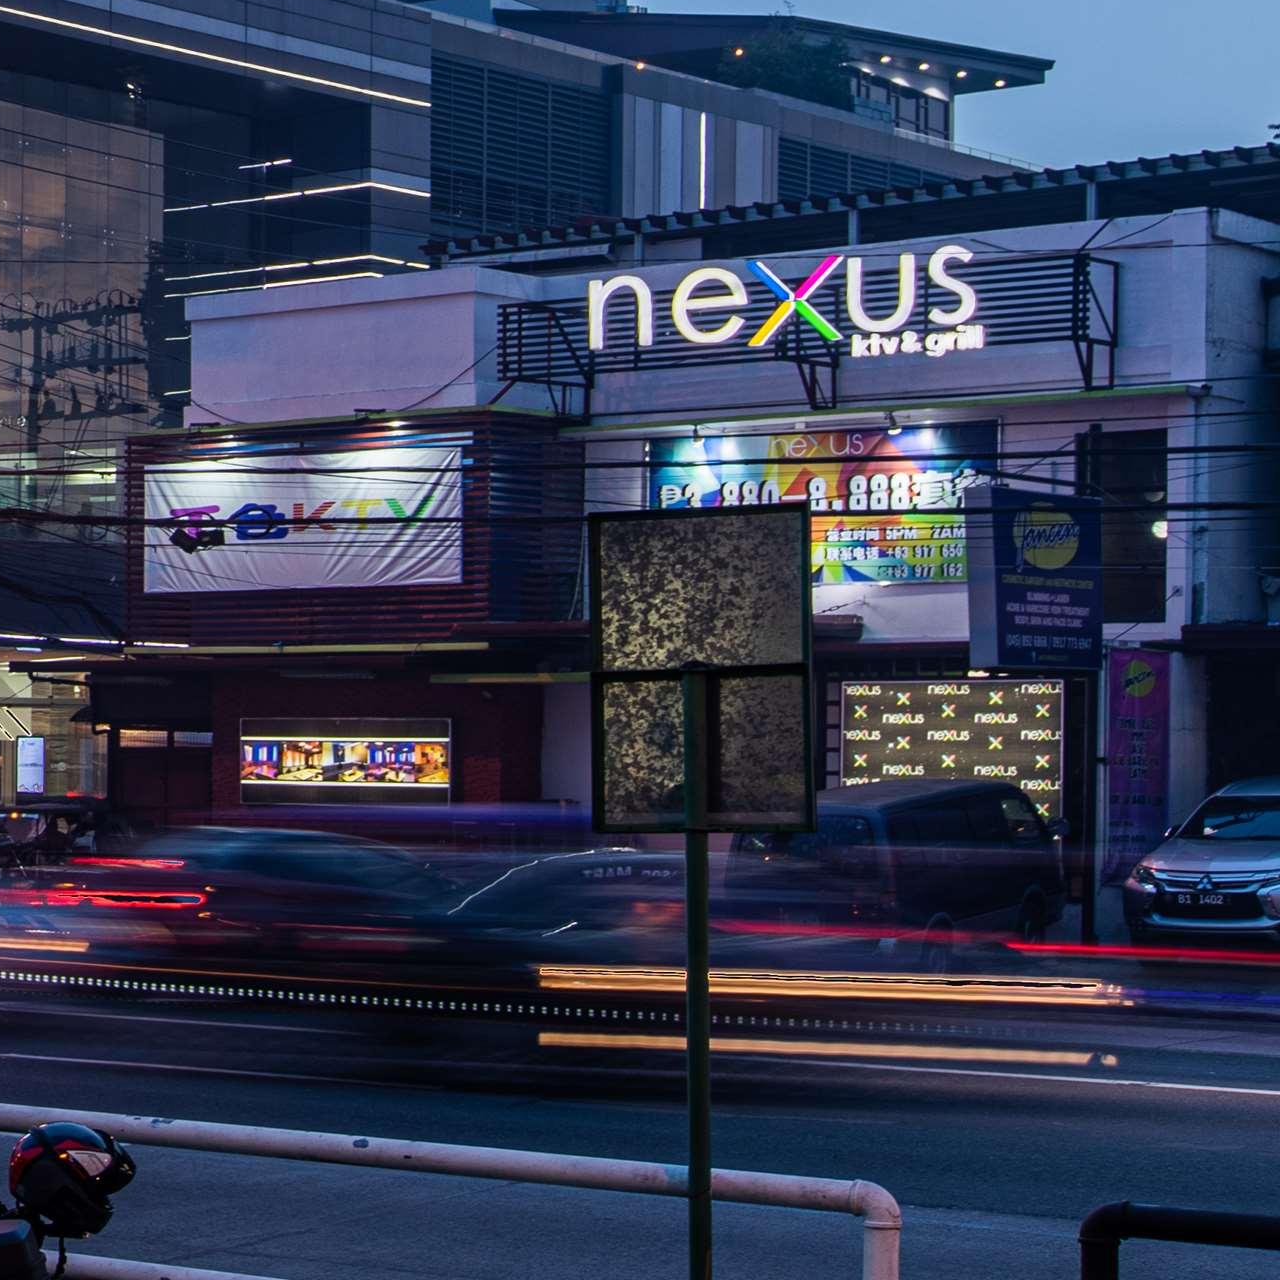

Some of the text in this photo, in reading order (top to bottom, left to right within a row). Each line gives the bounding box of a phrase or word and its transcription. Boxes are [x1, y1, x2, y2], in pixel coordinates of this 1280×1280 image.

[851, 325, 984, 358] ktv & grill
[885, 527, 917, 541] 5PM
